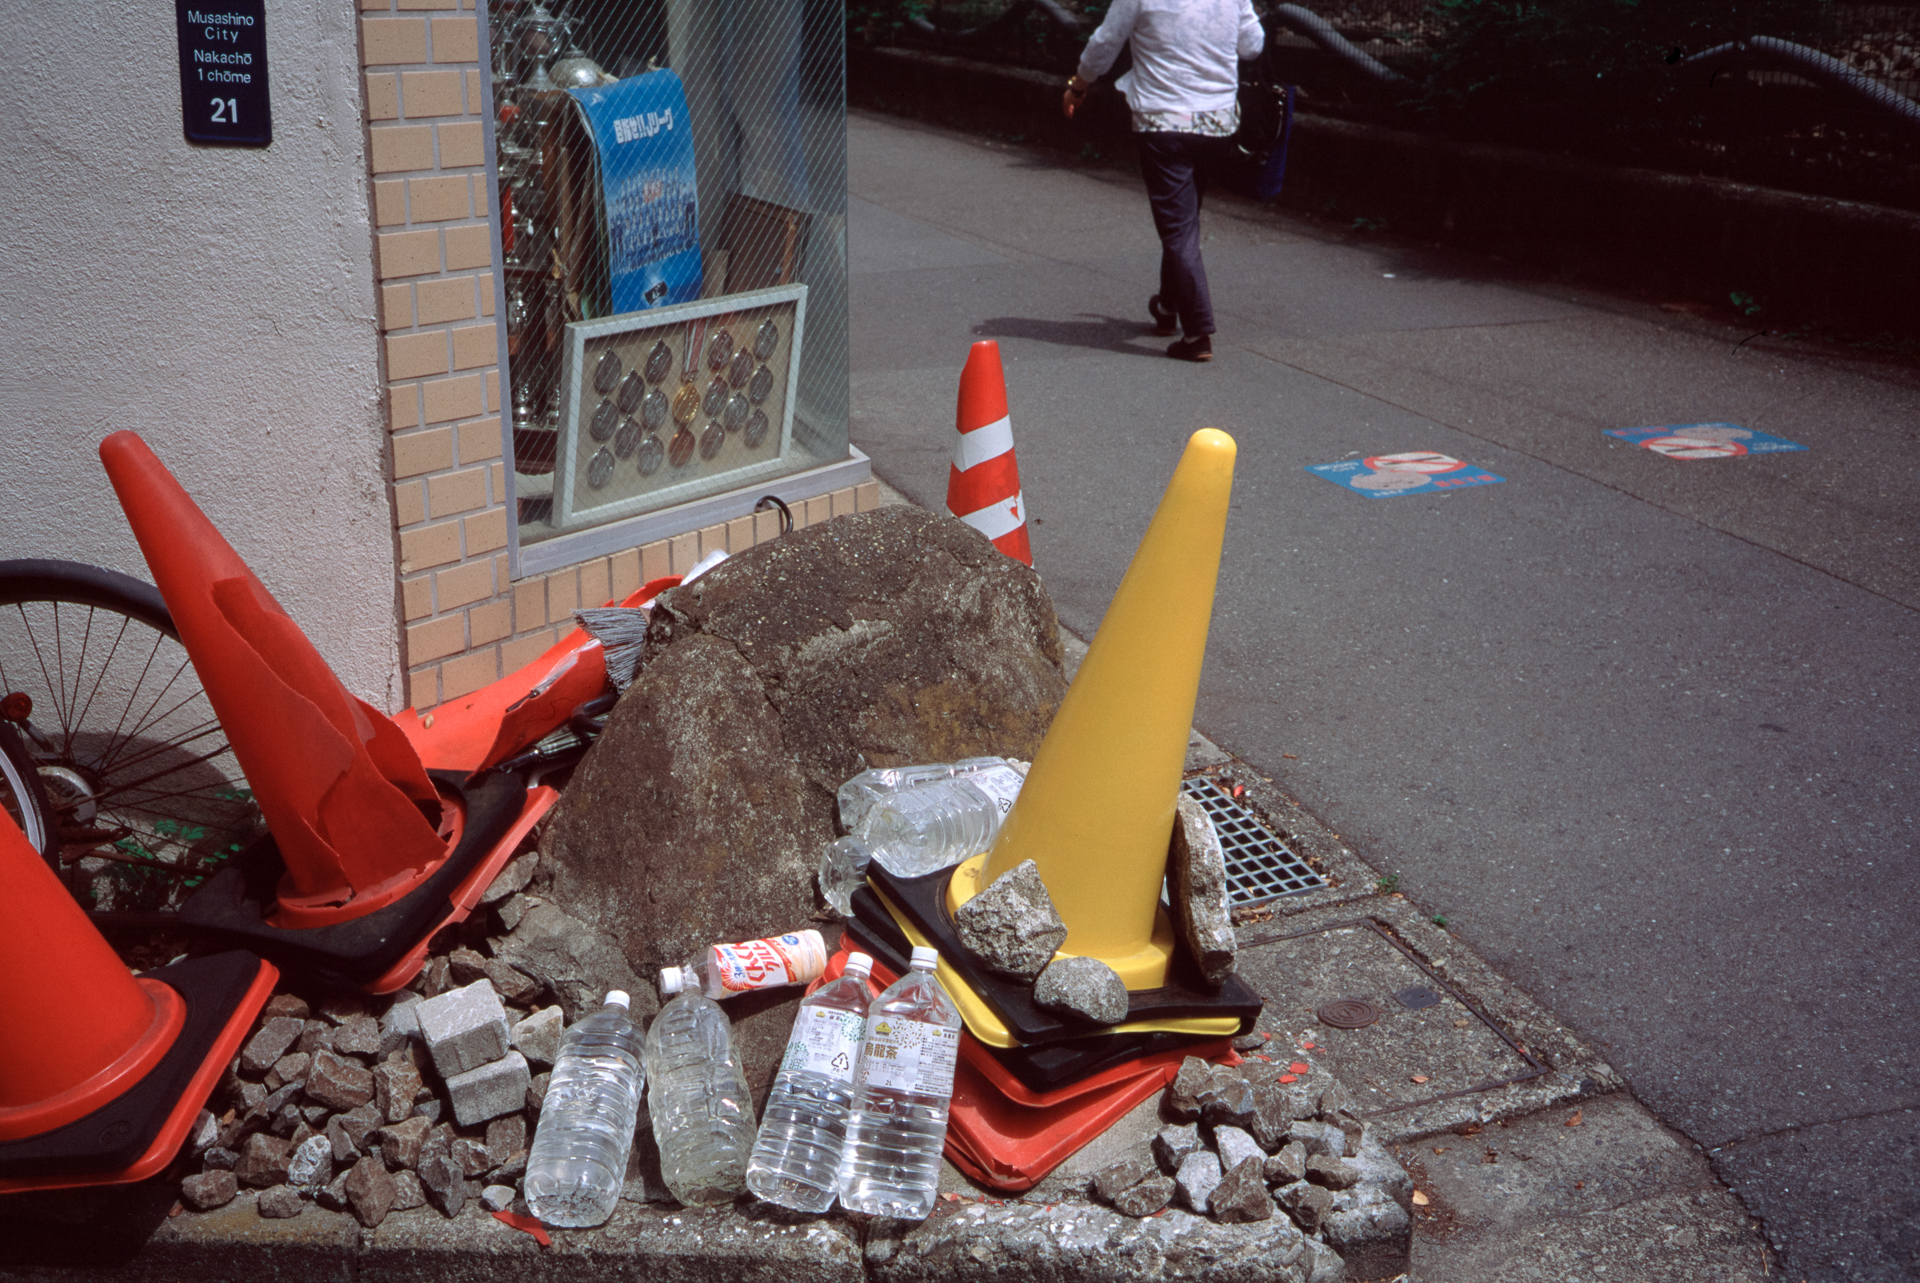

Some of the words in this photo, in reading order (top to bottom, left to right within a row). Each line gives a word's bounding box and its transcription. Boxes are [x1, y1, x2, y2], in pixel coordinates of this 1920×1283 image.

[187, 10, 255, 26] Musashino
[204, 26, 239, 43] City
[193, 49, 253, 65] Nakachō
[197, 67, 203, 81] 1
[207, 69, 252, 84] chōme
[210, 97, 238, 124] 21
[749, 942, 781, 972] グルト
[864, 1041, 899, 1060] 烏龍茶
[885, 1079, 893, 1087] 2L
